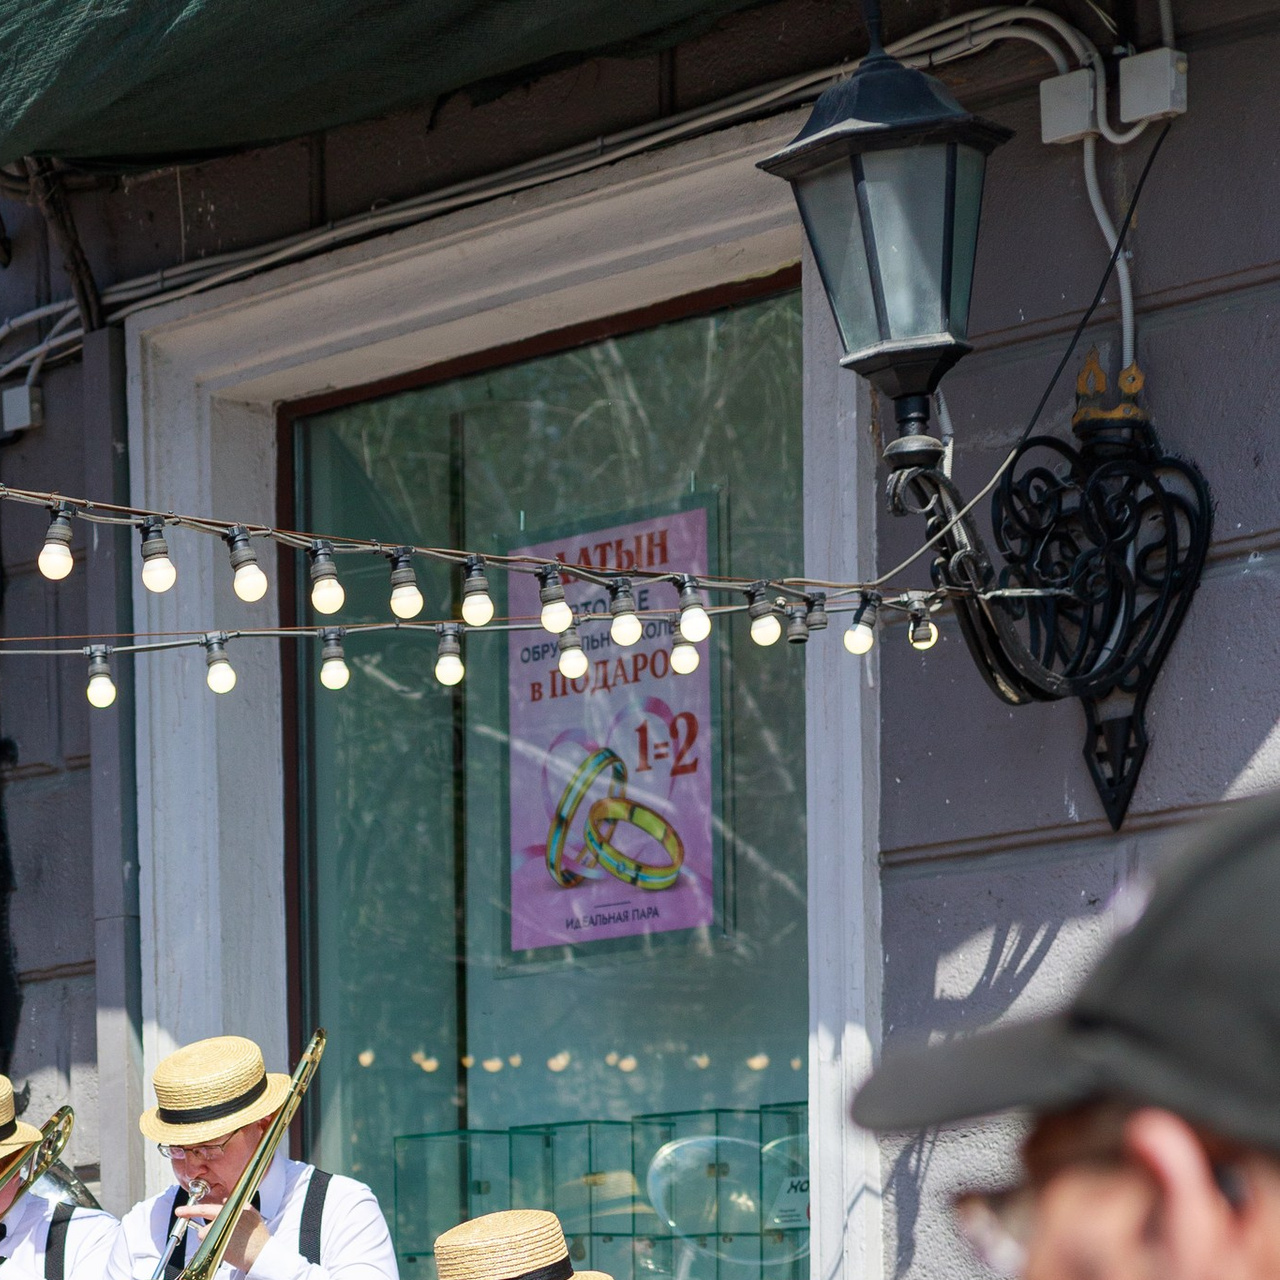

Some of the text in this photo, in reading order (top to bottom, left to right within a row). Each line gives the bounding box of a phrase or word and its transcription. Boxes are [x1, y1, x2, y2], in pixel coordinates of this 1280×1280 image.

[549, 648, 678, 699] ПОДАРО
[635, 711, 699, 777] 1=2
[565, 906, 660, 930] ИДЕАЛЬНАЯ ПАРА
